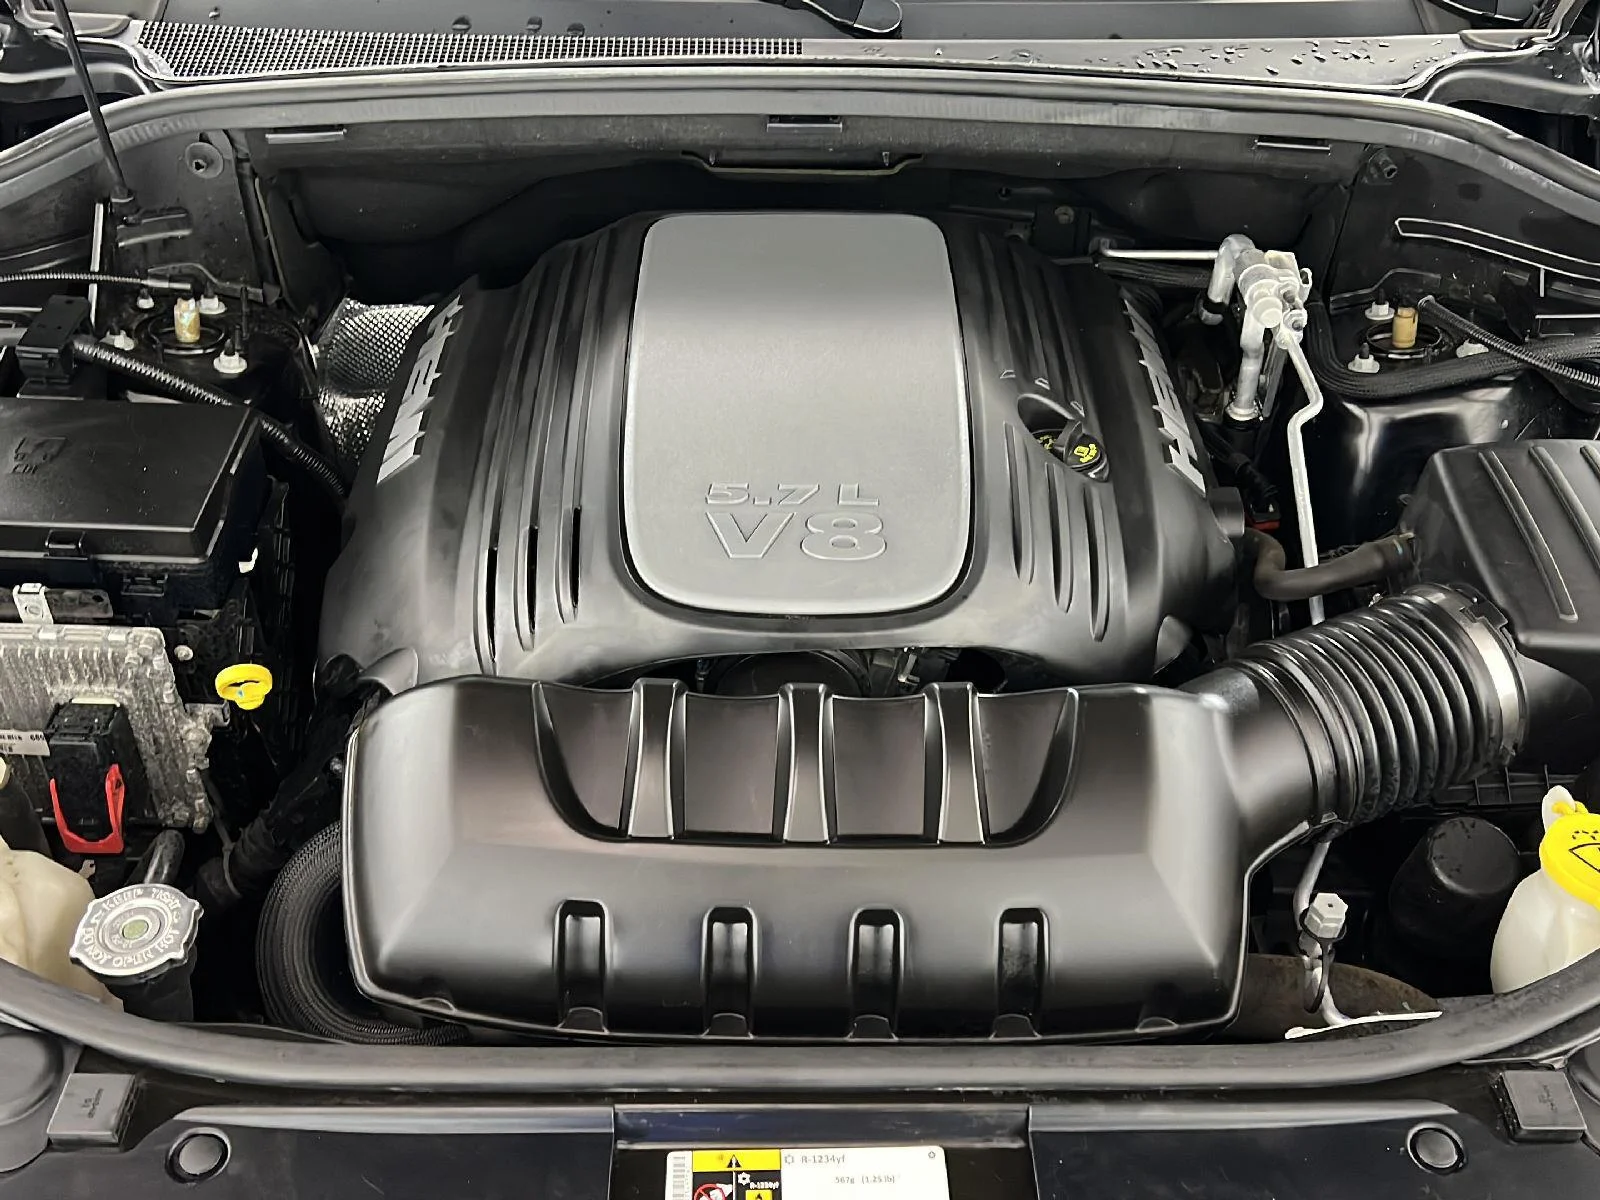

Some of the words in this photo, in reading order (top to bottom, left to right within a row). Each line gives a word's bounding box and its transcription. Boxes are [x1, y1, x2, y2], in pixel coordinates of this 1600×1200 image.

[705, 482, 820, 506] 5.7
[837, 482, 880, 506] L
[705, 511, 887, 561] V8
